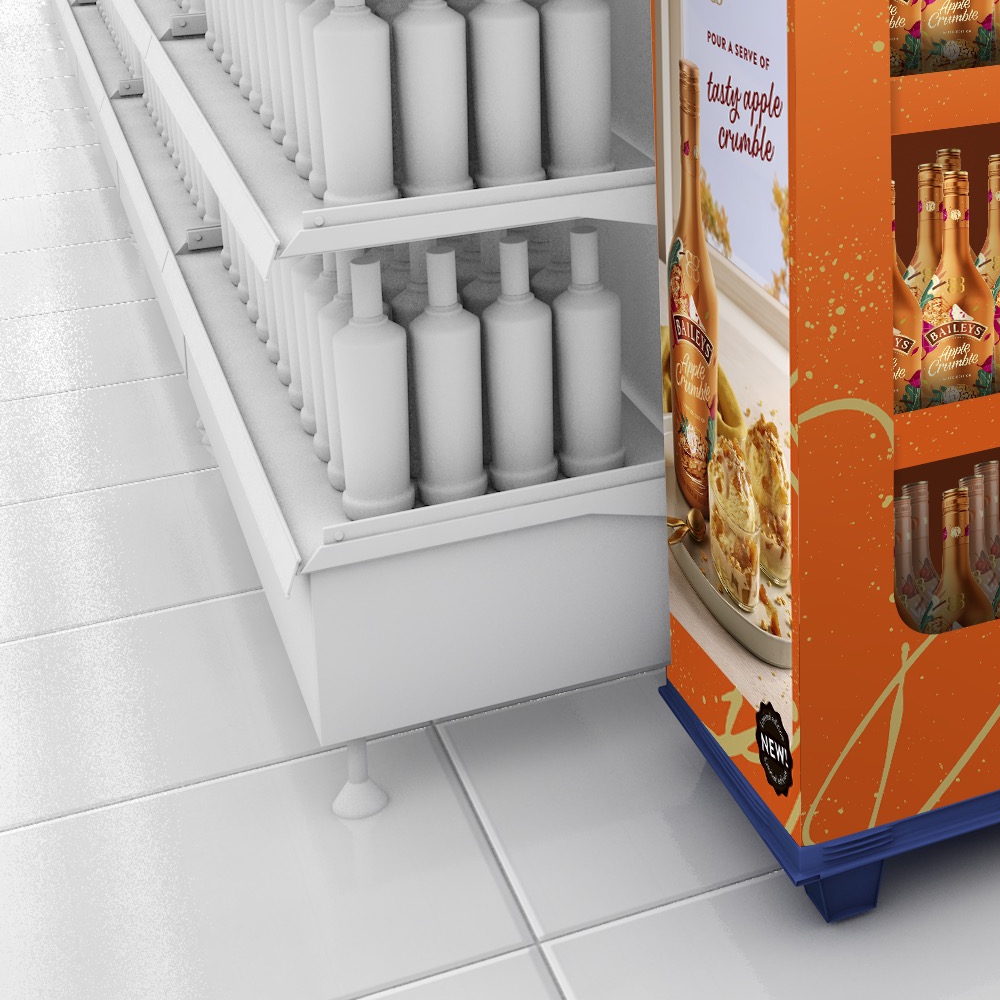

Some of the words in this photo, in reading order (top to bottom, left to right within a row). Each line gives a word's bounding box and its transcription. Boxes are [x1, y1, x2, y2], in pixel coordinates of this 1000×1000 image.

[927, 9, 979, 29] Crumble
[707, 30, 727, 50] POUR
[727, 41, 734, 54] A
[734, 43, 758, 66] SERVE
[759, 55, 770, 71] OF
[707, 71, 742, 124] tasty
[743, 81, 783, 129] apple
[718, 123, 775, 162] crumble
[675, 318, 711, 359] BAILEYS
[930, 323, 982, 342] BAILEYS
[938, 342, 971, 361] Apple
[675, 362, 711, 402] Crumble
[681, 353, 705, 380] Apple
[927, 353, 979, 377] Crumble
[760, 731, 790, 769] NEW!
